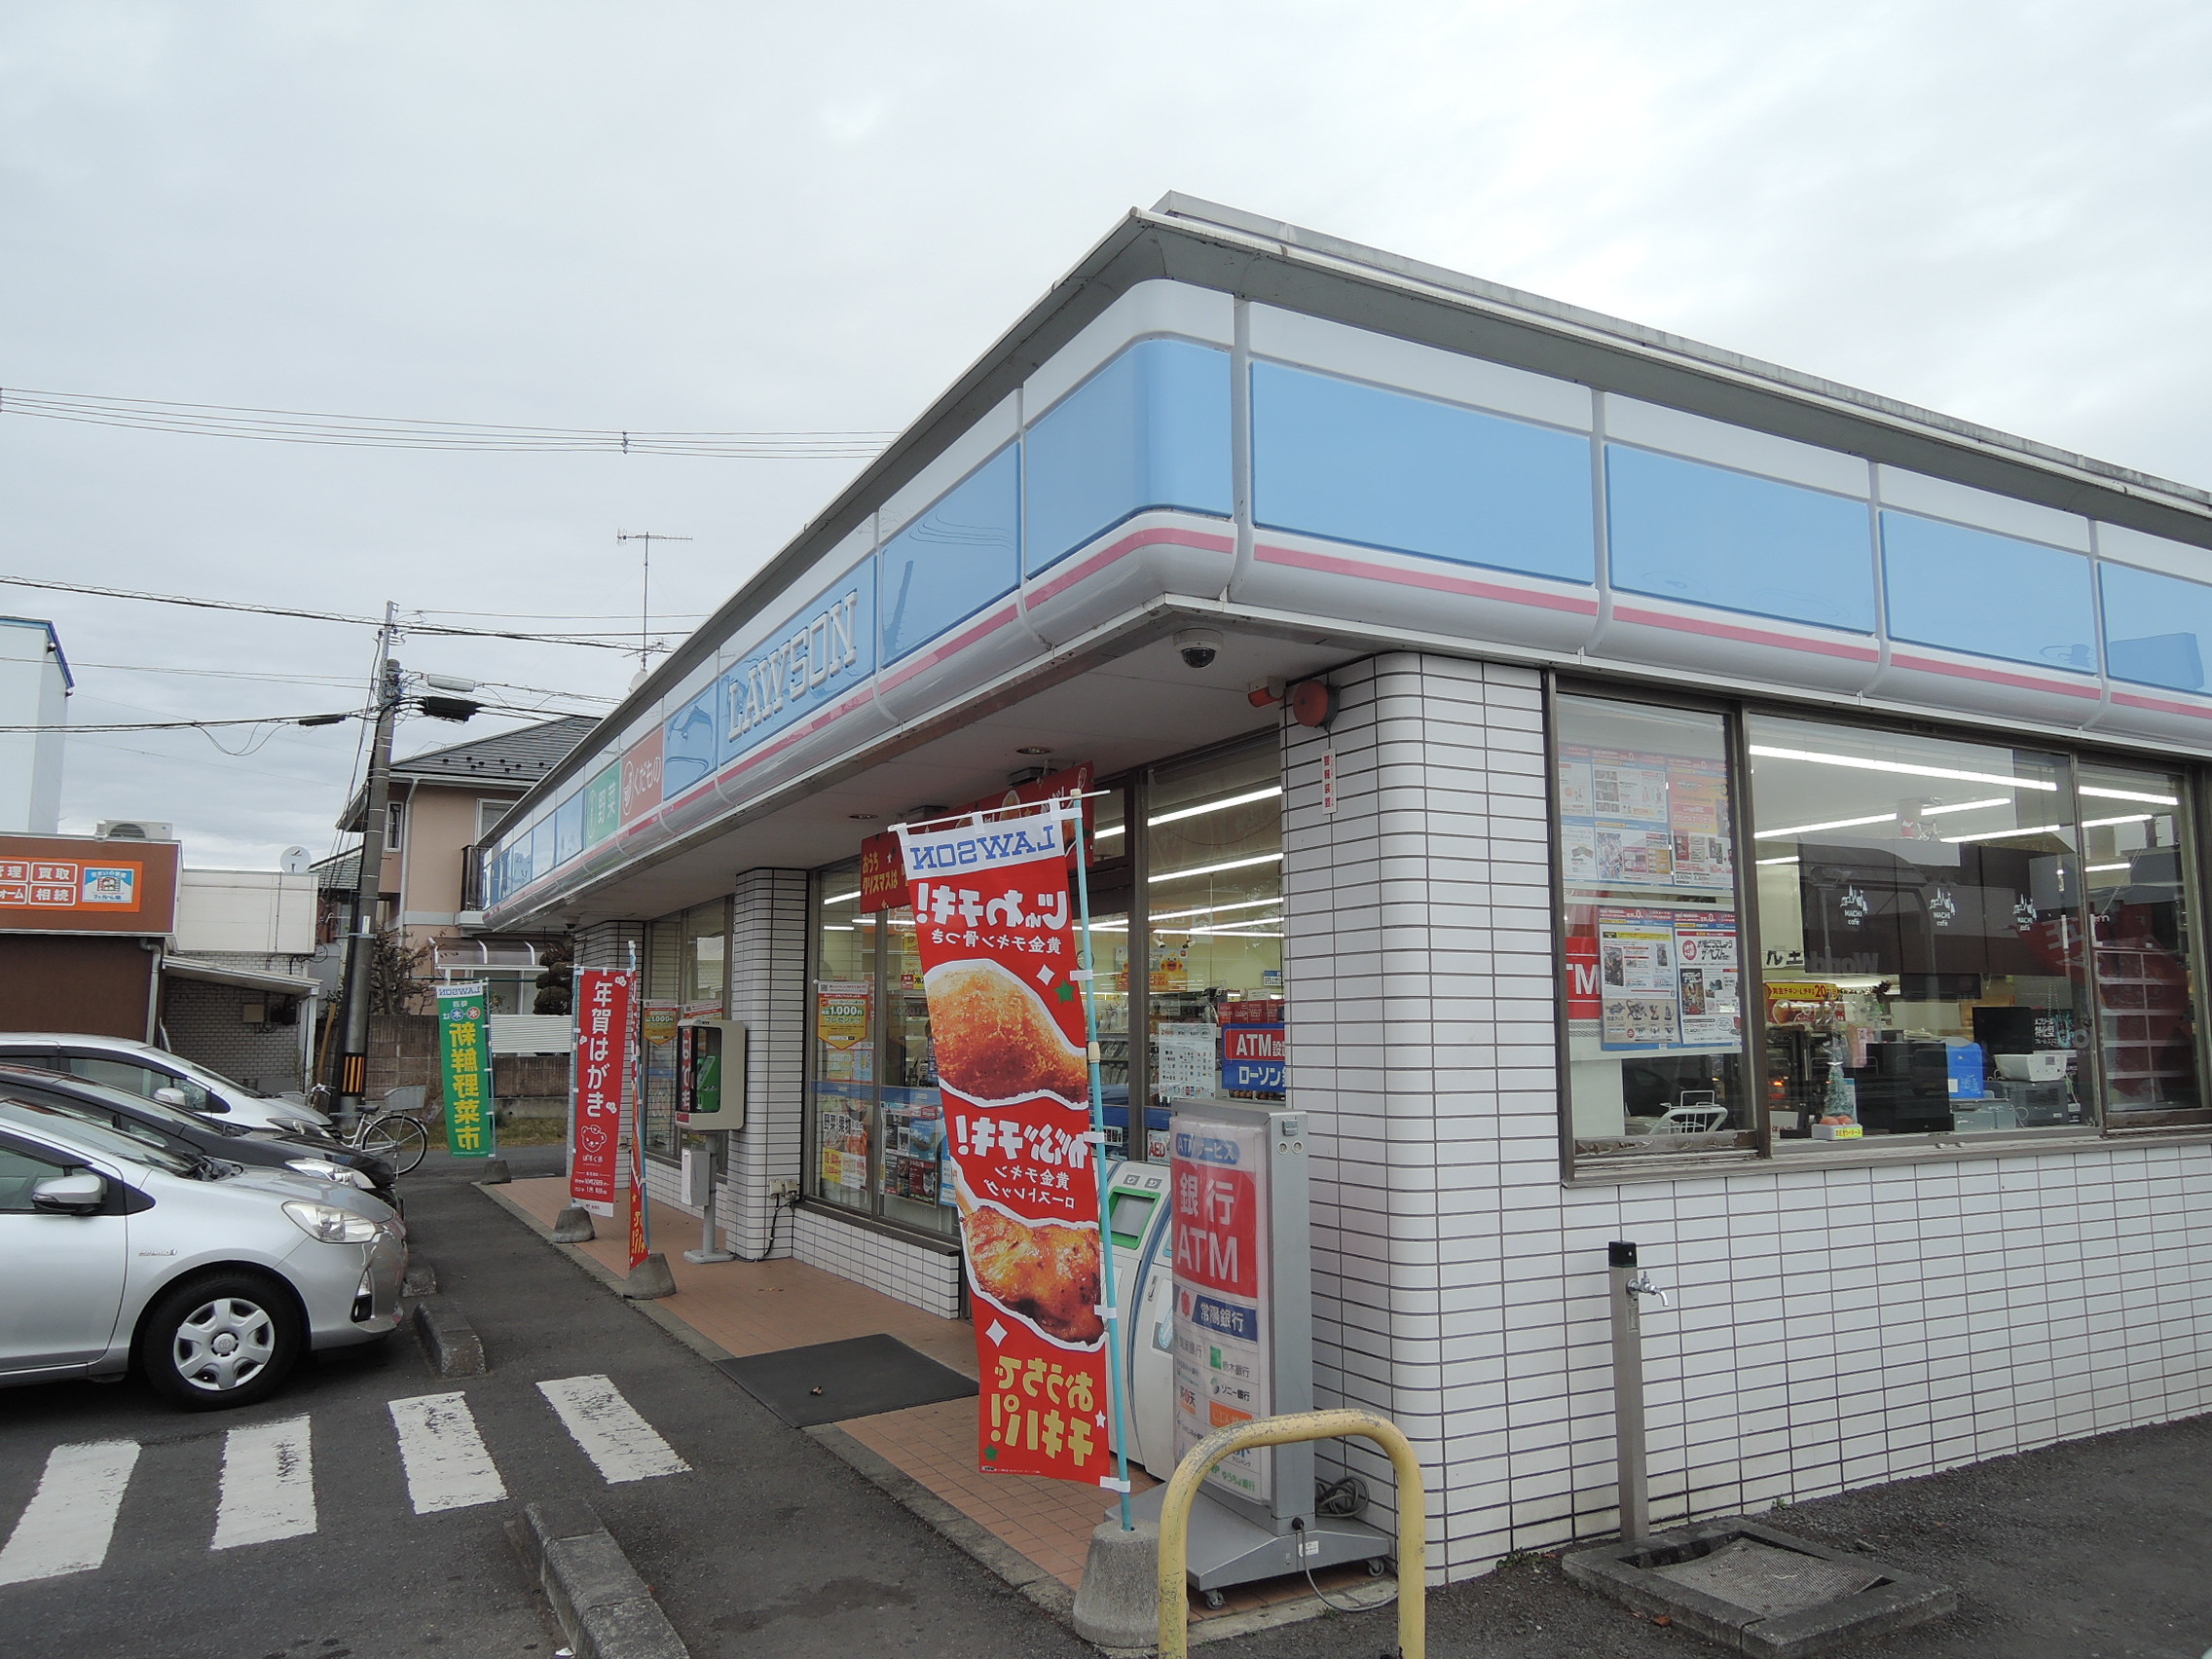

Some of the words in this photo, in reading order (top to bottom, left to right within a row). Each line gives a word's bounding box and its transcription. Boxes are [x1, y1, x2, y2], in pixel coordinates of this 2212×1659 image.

[729, 588, 857, 743] LAWSON
[633, 756, 662, 796] くだもの
[598, 782, 617, 824] 野菜
[38, 866, 70, 880] 買取
[863, 850, 879, 873] おうち
[36, 888, 69, 902] 相続
[863, 874, 899, 896] クリスマスは
[587, 980, 613, 1117] 年賀はがき
[1148, 1141, 1165, 1158] AED
[1179, 1171, 1235, 1226] 銀行
[1177, 1223, 1238, 1283] ATM
[1199, 1302, 1244, 1333] 常陽銀行
[1221, 1384, 1250, 1402] ソニー銀行
[1222, 1471, 1255, 1492] ゆうちょ銀行
